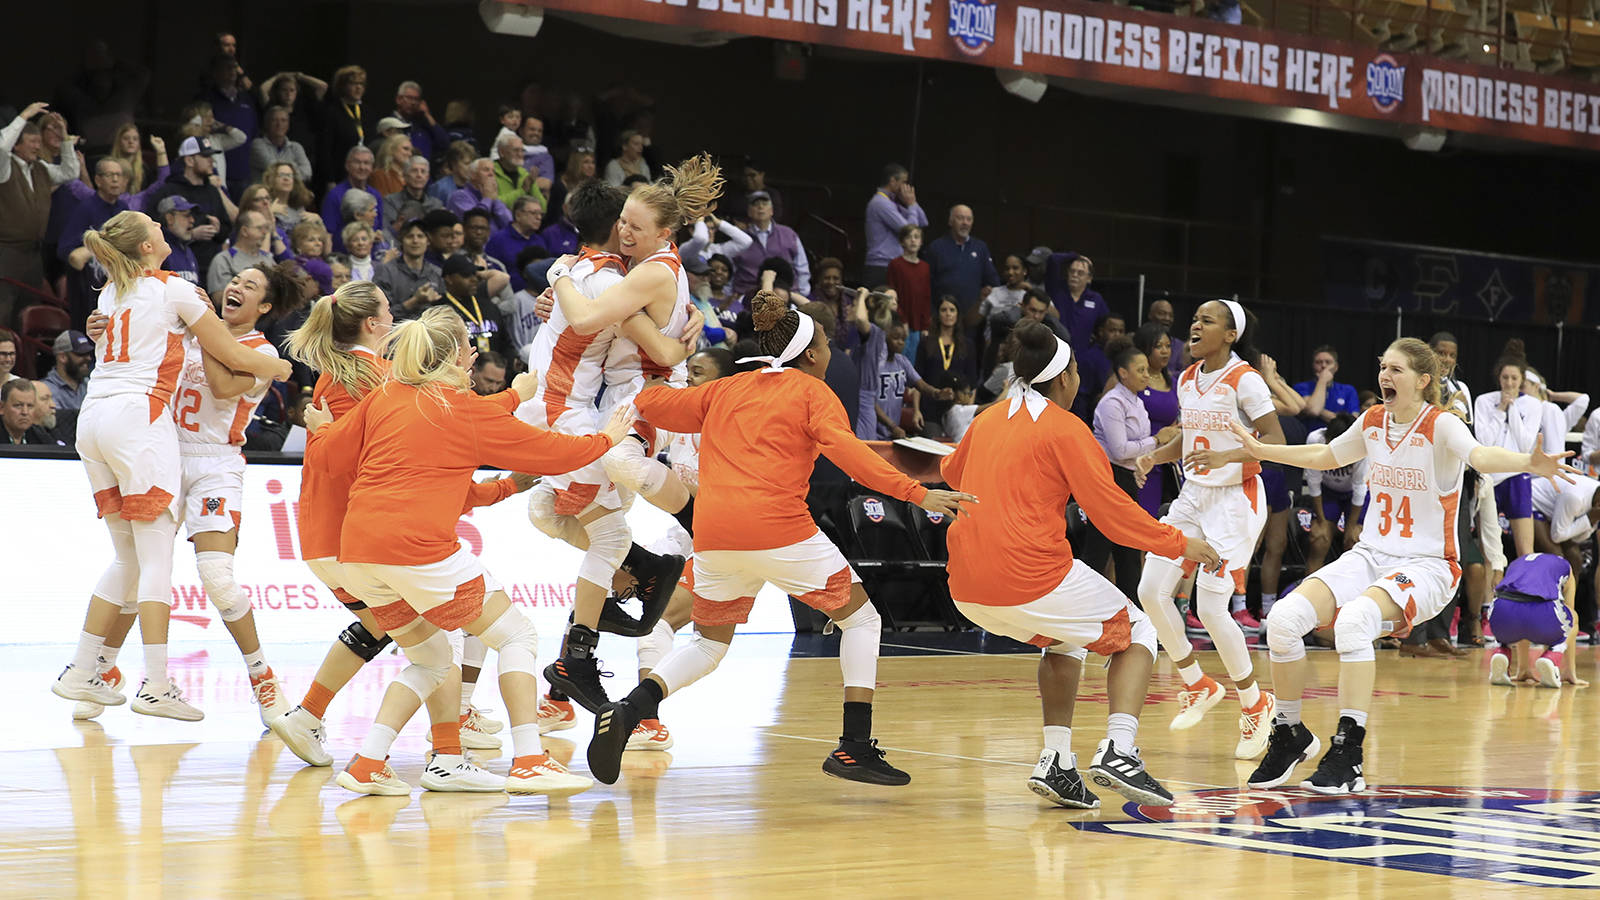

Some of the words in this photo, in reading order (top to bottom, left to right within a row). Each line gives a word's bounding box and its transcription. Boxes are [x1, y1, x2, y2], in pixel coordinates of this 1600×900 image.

[1013, 6, 1161, 70] MADNESS
[1168, 29, 1279, 88] BEGINS
[1285, 48, 1354, 109] HERE
[1421, 69, 1538, 126] MADNESS
[1544, 88, 1600, 135] BEGI
[104, 308, 131, 363] 11
[1376, 491, 1414, 538] 34
